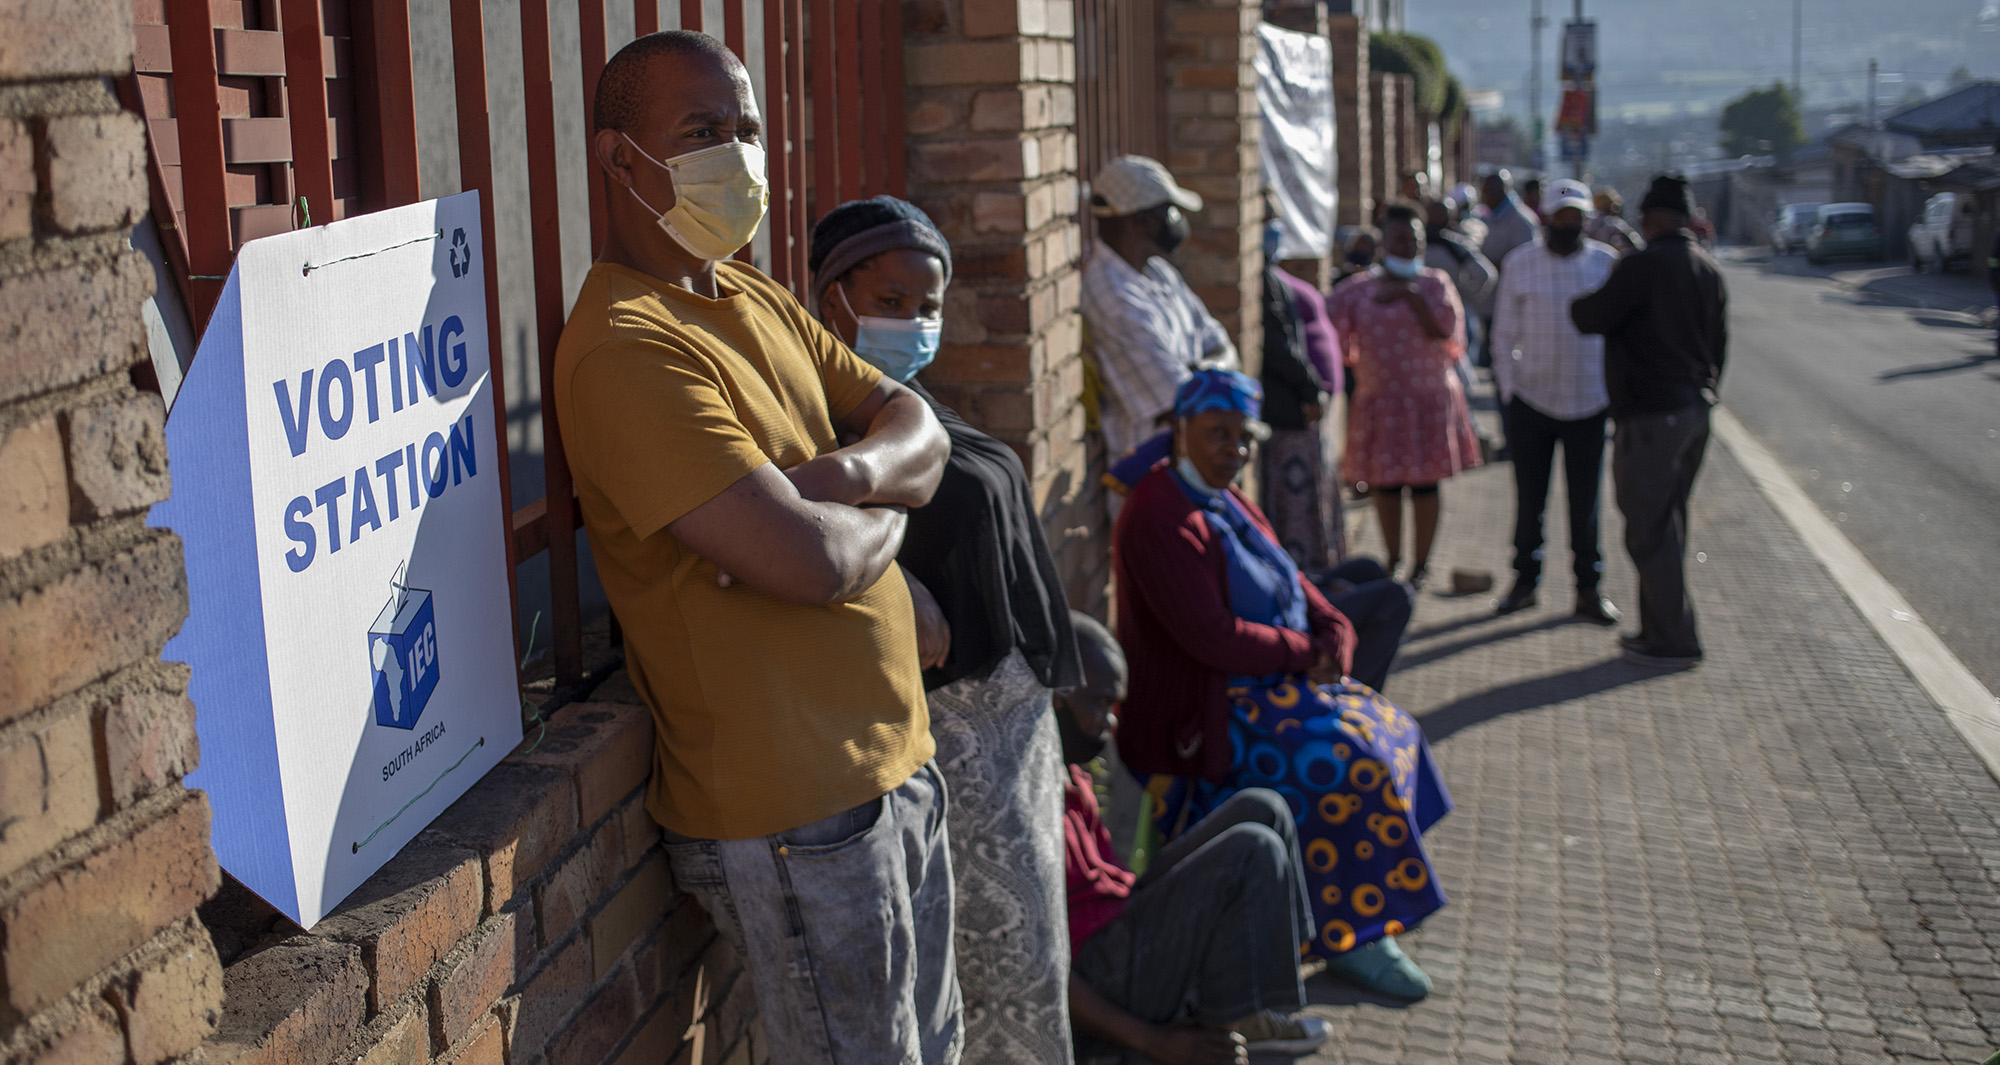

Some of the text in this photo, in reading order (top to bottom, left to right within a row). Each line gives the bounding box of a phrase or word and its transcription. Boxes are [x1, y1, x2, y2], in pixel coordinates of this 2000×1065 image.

[273, 315, 468, 458] VOTING
[283, 414, 477, 573] STATION
[408, 621, 434, 692] IEC
[382, 721, 446, 782] SOUTH AFRICA
